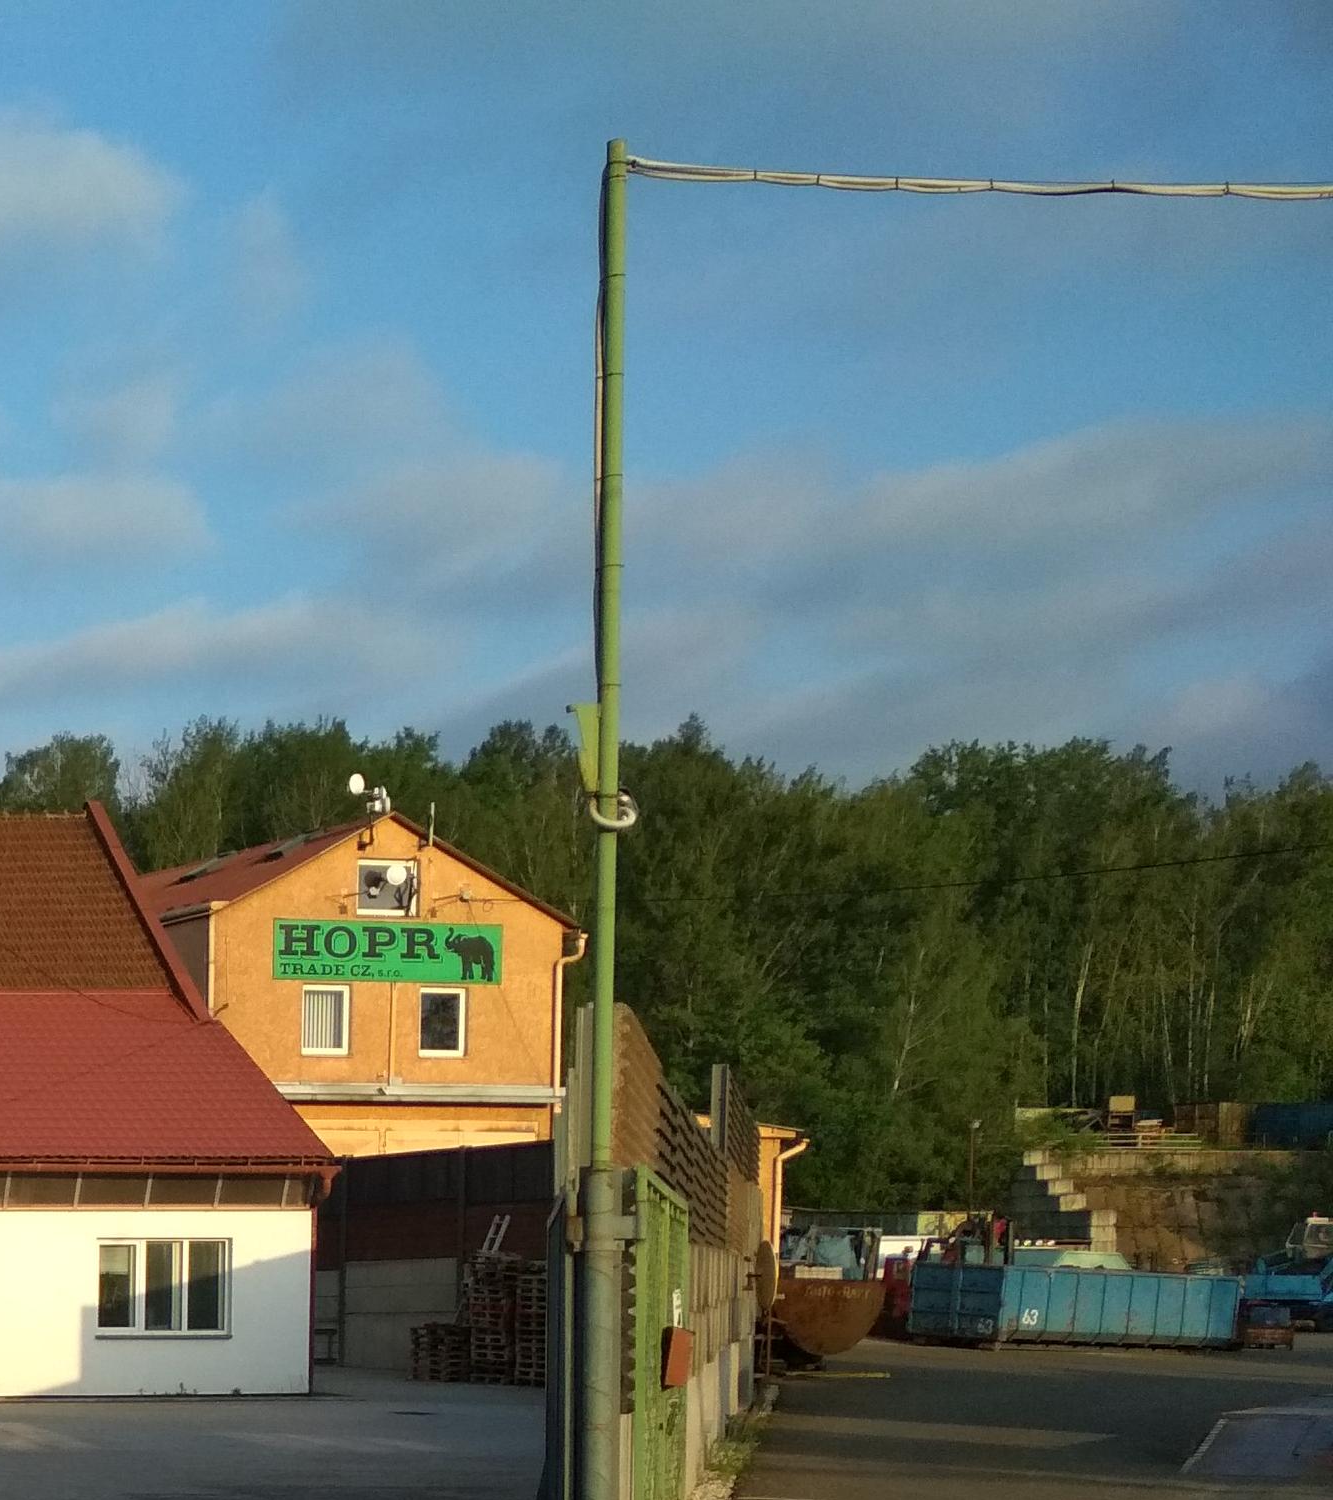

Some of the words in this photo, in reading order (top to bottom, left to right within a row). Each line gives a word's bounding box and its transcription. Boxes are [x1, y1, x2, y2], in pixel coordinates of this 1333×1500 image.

[278, 924, 441, 961] HOPR
[279, 963, 345, 976] TRADE
[1022, 1308, 1039, 1326] 63
